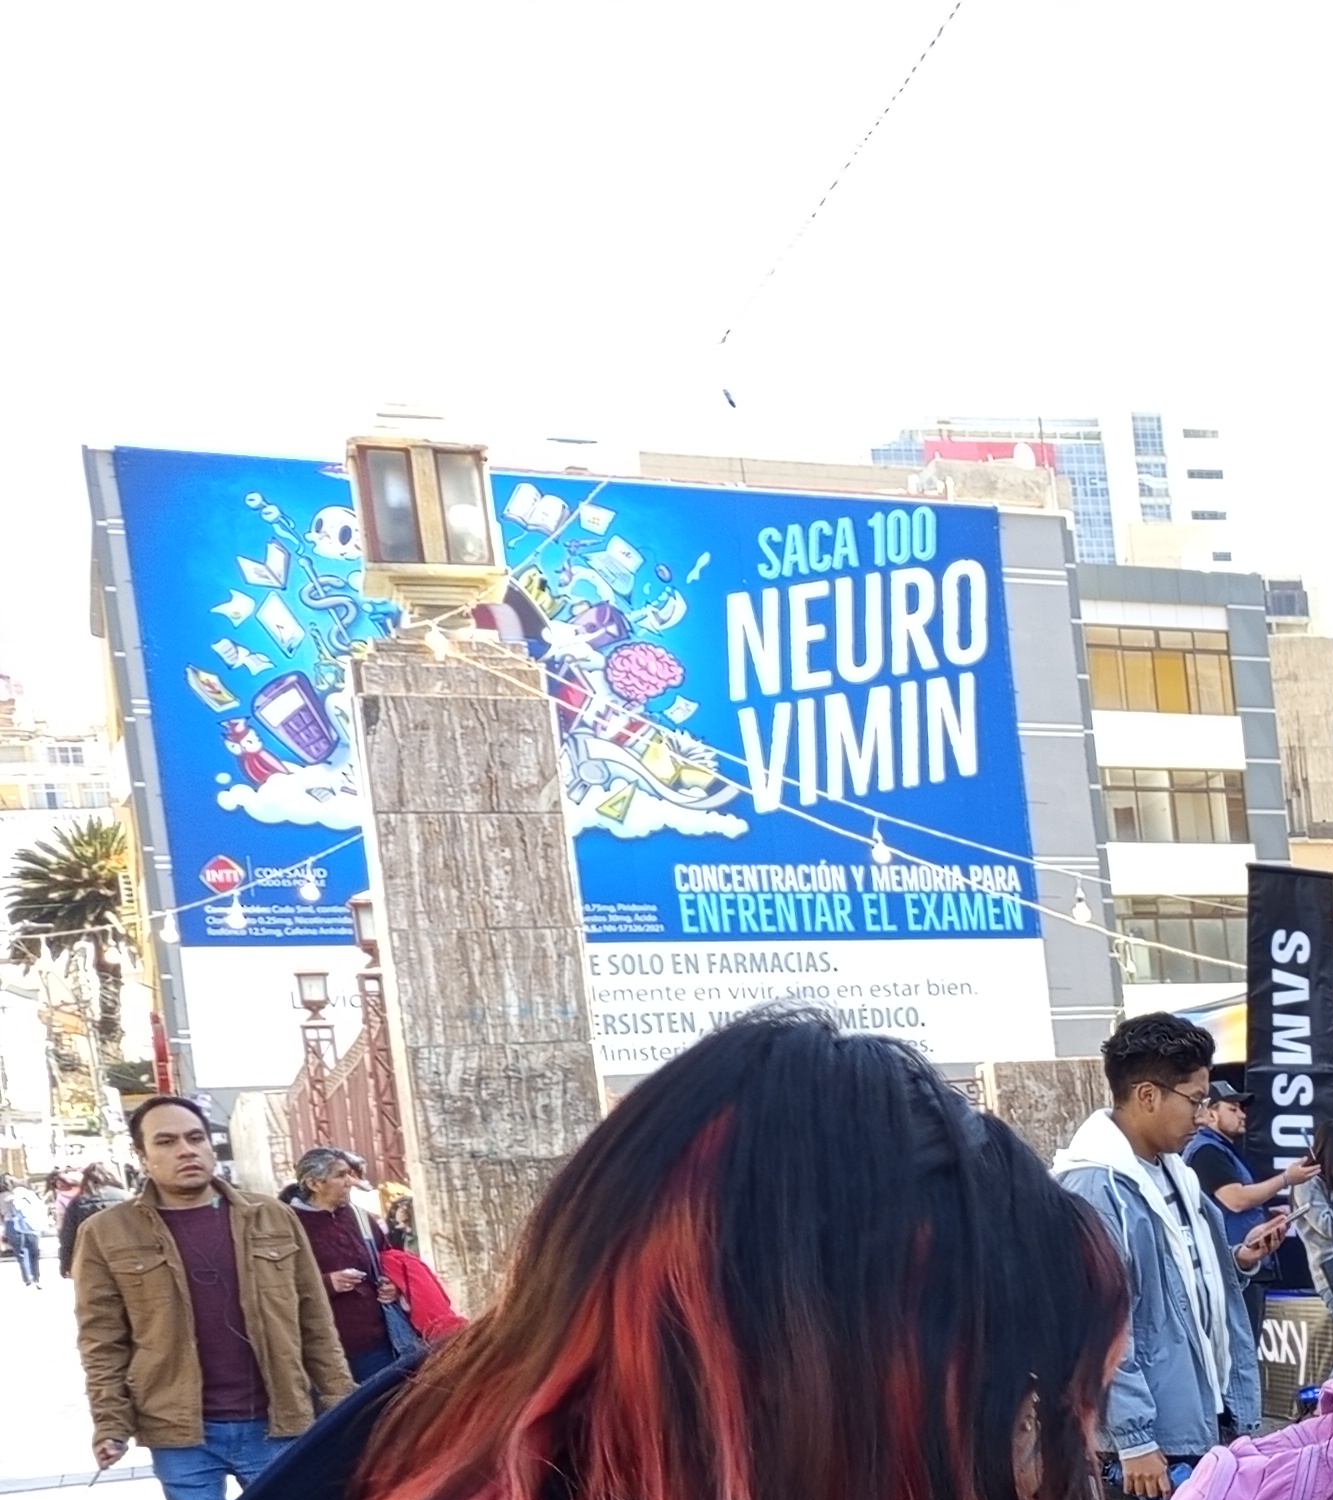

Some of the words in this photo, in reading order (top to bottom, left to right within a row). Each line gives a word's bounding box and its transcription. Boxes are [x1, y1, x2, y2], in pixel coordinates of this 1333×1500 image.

[758, 516, 860, 580] SACA
[868, 506, 938, 567] 100
[727, 559, 989, 702] NEURO
[738, 672, 979, 814] VIMIN
[205, 869, 240, 883] INTI
[674, 859, 847, 893] CONCENTRACIÓN
[852, 865, 865, 892] Y
[871, 865, 965, 892] MEMORIA
[969, 865, 1021, 892] PARA
[678, 893, 855, 933] ENFRENTAR
[862, 893, 897, 932] EL
[904, 892, 1024, 931] EXAMEN
[607, 953, 664, 976] SOLO
[671, 953, 700, 975] EN
[706, 951, 838, 975] FARMACIAS.
[694, 987, 720, 1001] en
[786, 981, 830, 999] sino
[837, 983, 863, 998] en
[870, 980, 921, 997] estar
[927, 979, 979, 996] bien.
[838, 1003, 926, 1030] MÉDICO.
[1271, 929, 1315, 1196] SAMSU
[1258, 1319, 1308, 1386] axy
